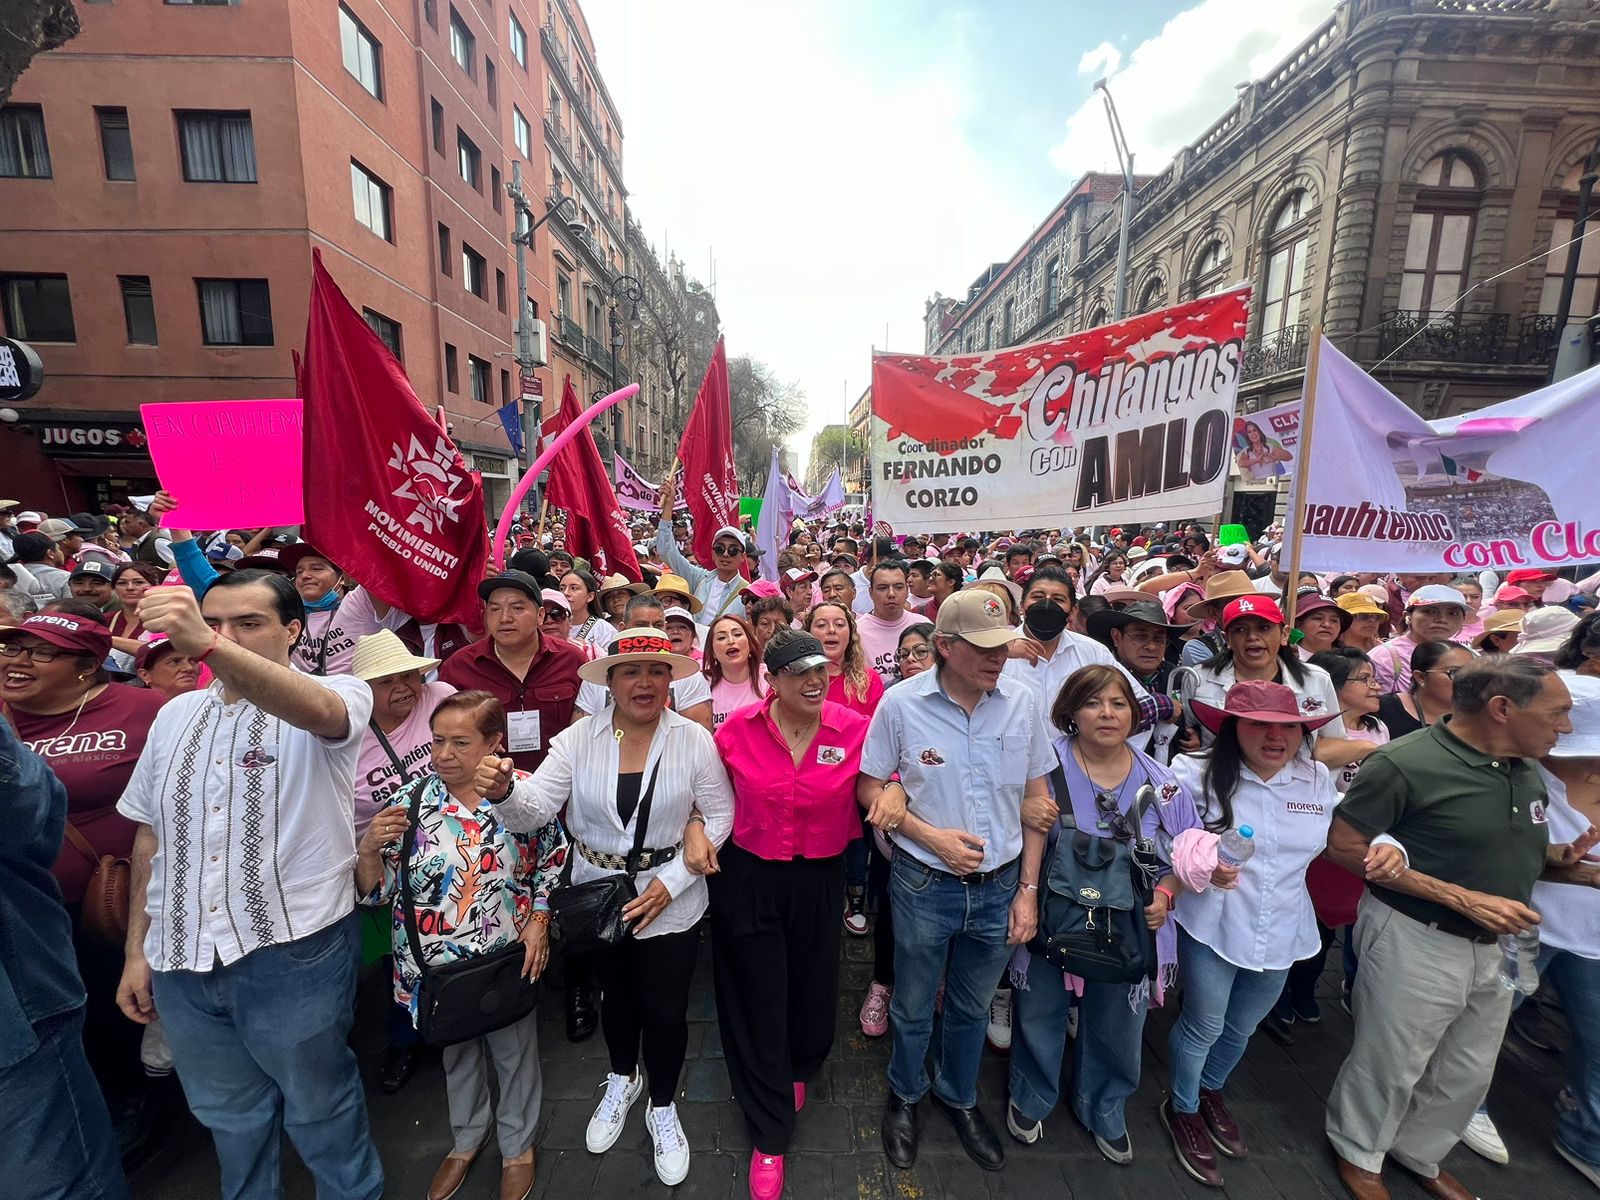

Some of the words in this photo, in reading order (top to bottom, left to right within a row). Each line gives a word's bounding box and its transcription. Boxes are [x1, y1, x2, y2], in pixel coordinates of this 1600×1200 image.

[1027, 339, 1242, 441] Chilangos
[152, 414, 185, 438] EN
[1273, 412, 1300, 428] CLA
[43, 428, 121, 445] JUGOS
[883, 453, 1001, 480] FERNANDO
[1029, 446, 1077, 476] con
[1073, 408, 1231, 512] AMLO
[905, 486, 978, 508] CORZO
[364, 499, 459, 569] MOVIMIENTO
[368, 522, 412, 559] PUEBLO
[413, 555, 449, 580] UNIDO
[1443, 538, 1527, 568] con
[1239, 599, 1254, 612] LA
[1287, 801, 1323, 811] morena
